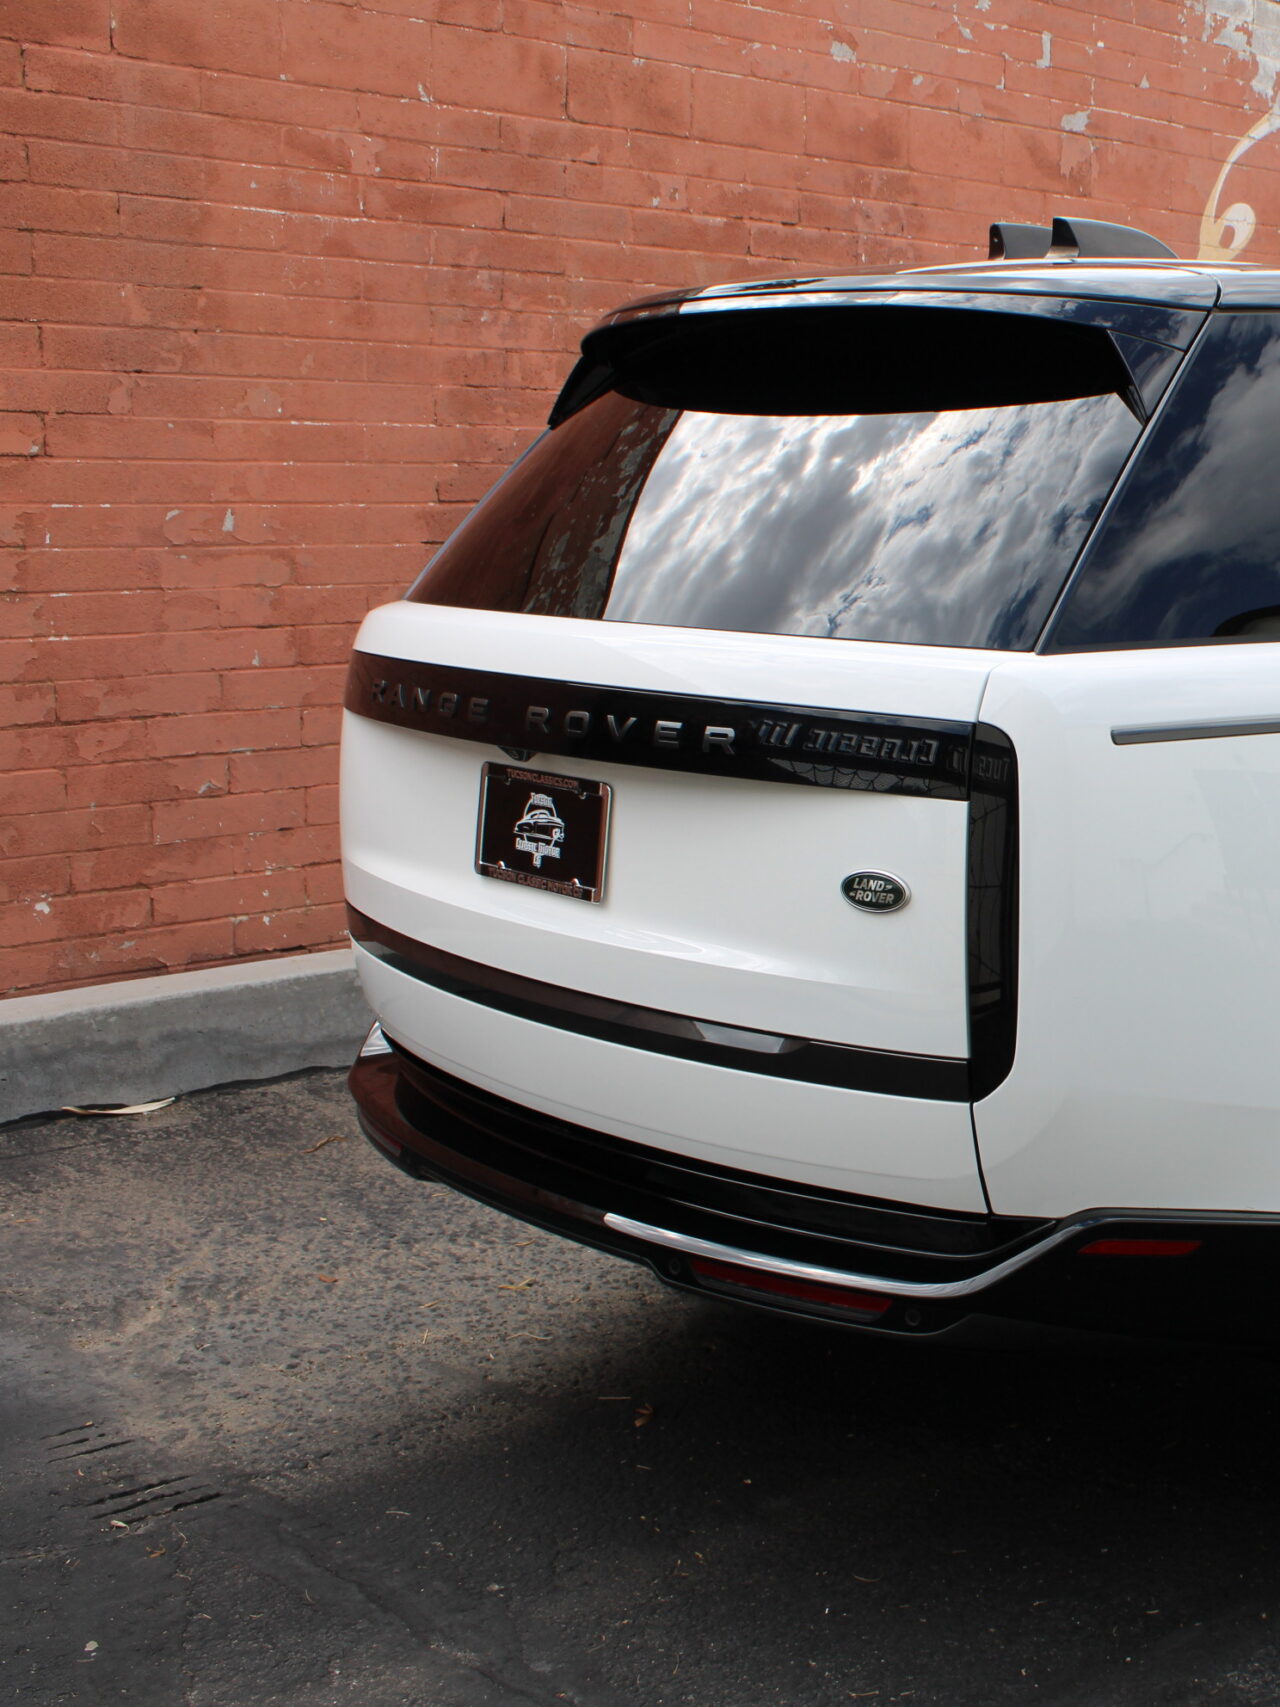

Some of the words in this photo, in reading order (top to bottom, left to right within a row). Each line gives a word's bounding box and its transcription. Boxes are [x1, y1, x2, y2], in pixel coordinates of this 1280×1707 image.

[370, 680, 490, 722] RANGE
[526, 706, 736, 755] ROVER
[853, 878, 885, 891] LAND
[855, 891, 895, 903] ROVER
